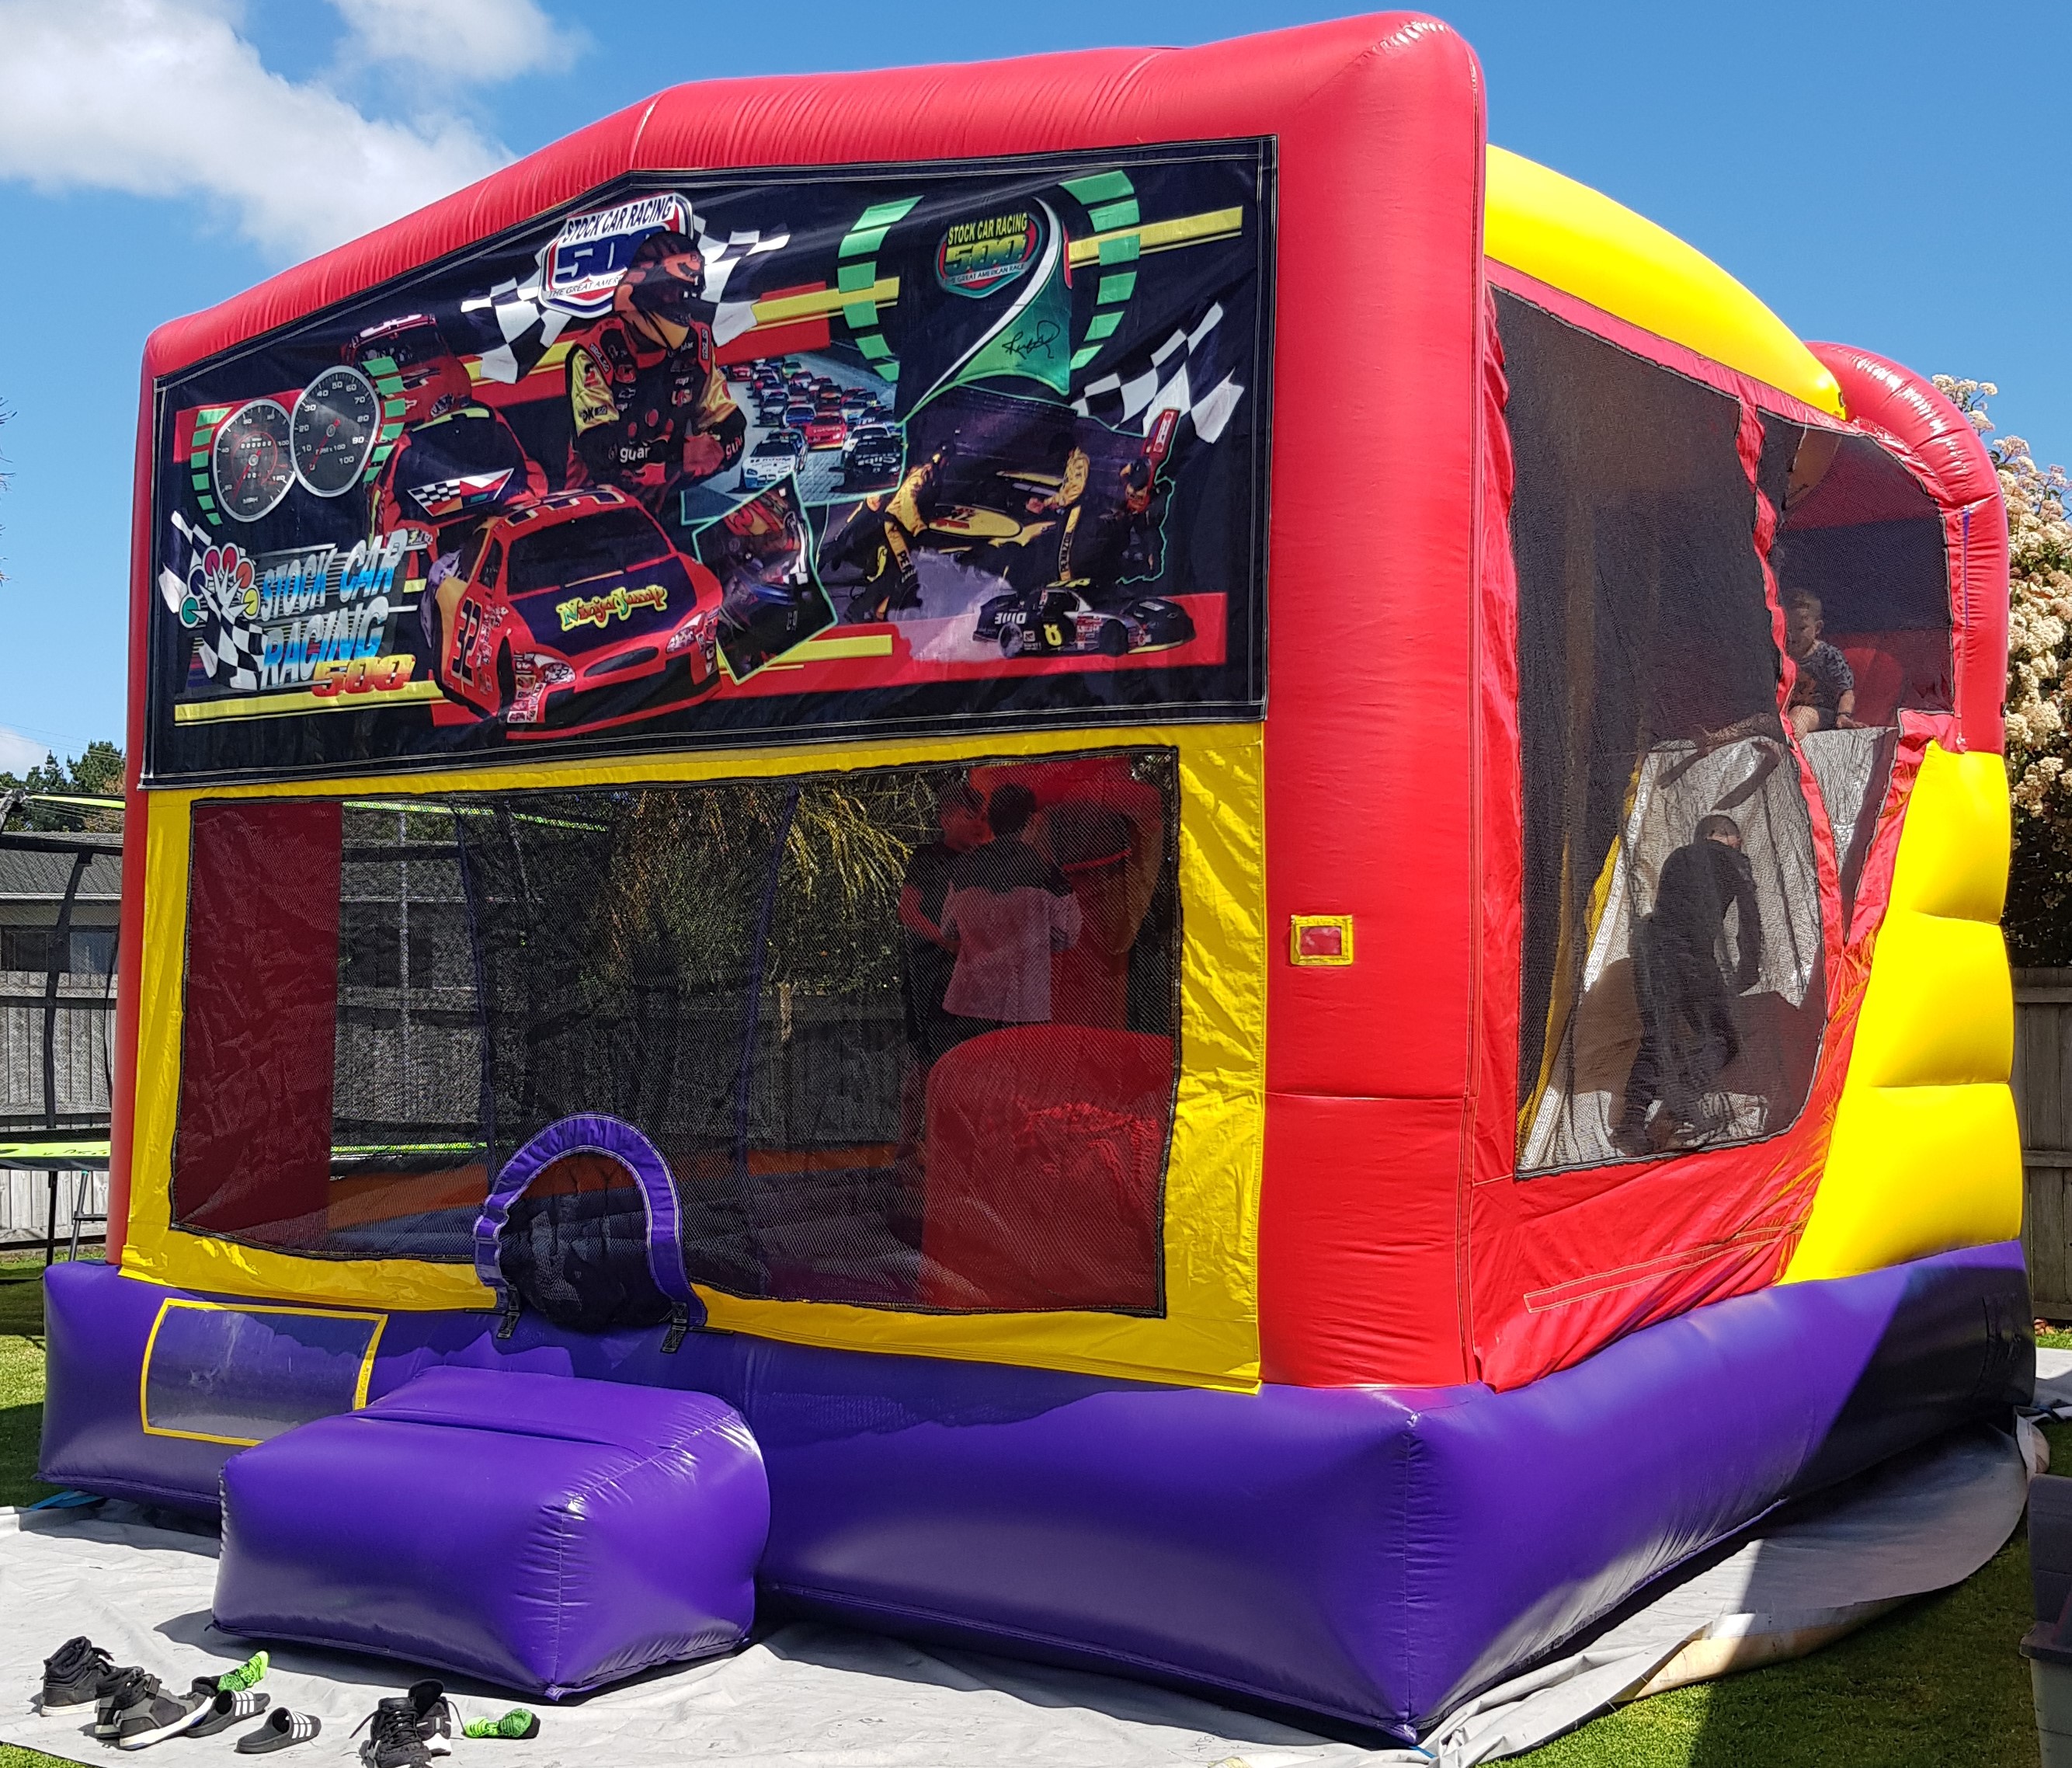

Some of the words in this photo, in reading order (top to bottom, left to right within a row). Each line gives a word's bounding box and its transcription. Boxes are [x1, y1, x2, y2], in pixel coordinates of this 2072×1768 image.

[561, 214, 603, 244] STOCK
[601, 207, 628, 232] CAR
[625, 195, 674, 228] RACING
[947, 222, 976, 245] STOCK
[976, 218, 995, 238] CAR
[994, 212, 1028, 236] RACING
[944, 234, 1027, 278] 500
[548, 287, 565, 298] THE
[565, 280, 593, 294] GREAT
[957, 272, 977, 284] GREAT
[977, 266, 1009, 279] AMERICAN
[1009, 263, 1025, 273] RACE
[304, 404, 316, 412] 30
[353, 395, 366, 404] 70
[339, 455, 355, 465] 100
[260, 547, 339, 622] STOCK
[339, 527, 408, 604] CAR
[260, 596, 389, 691] RACING
[311, 654, 417, 698] 500
